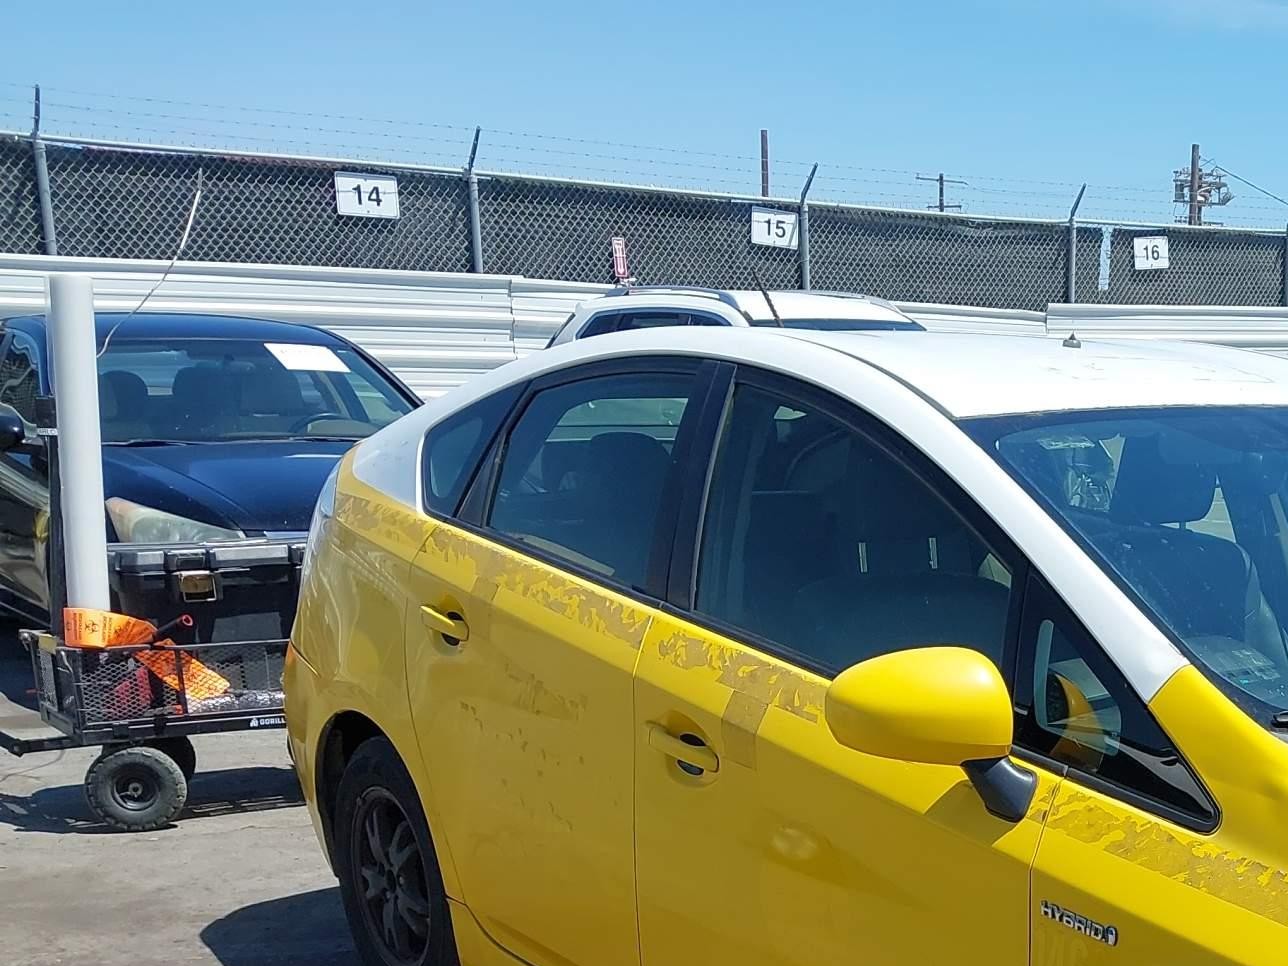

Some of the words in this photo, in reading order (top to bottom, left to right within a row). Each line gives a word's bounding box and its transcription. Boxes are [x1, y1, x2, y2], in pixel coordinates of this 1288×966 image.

[352, 184, 382, 207] 14
[764, 219, 786, 238] 15
[1143, 245, 1160, 261] 16
[260, 717, 286, 726] GORILL
[1041, 900, 1105, 941] HYBRID
